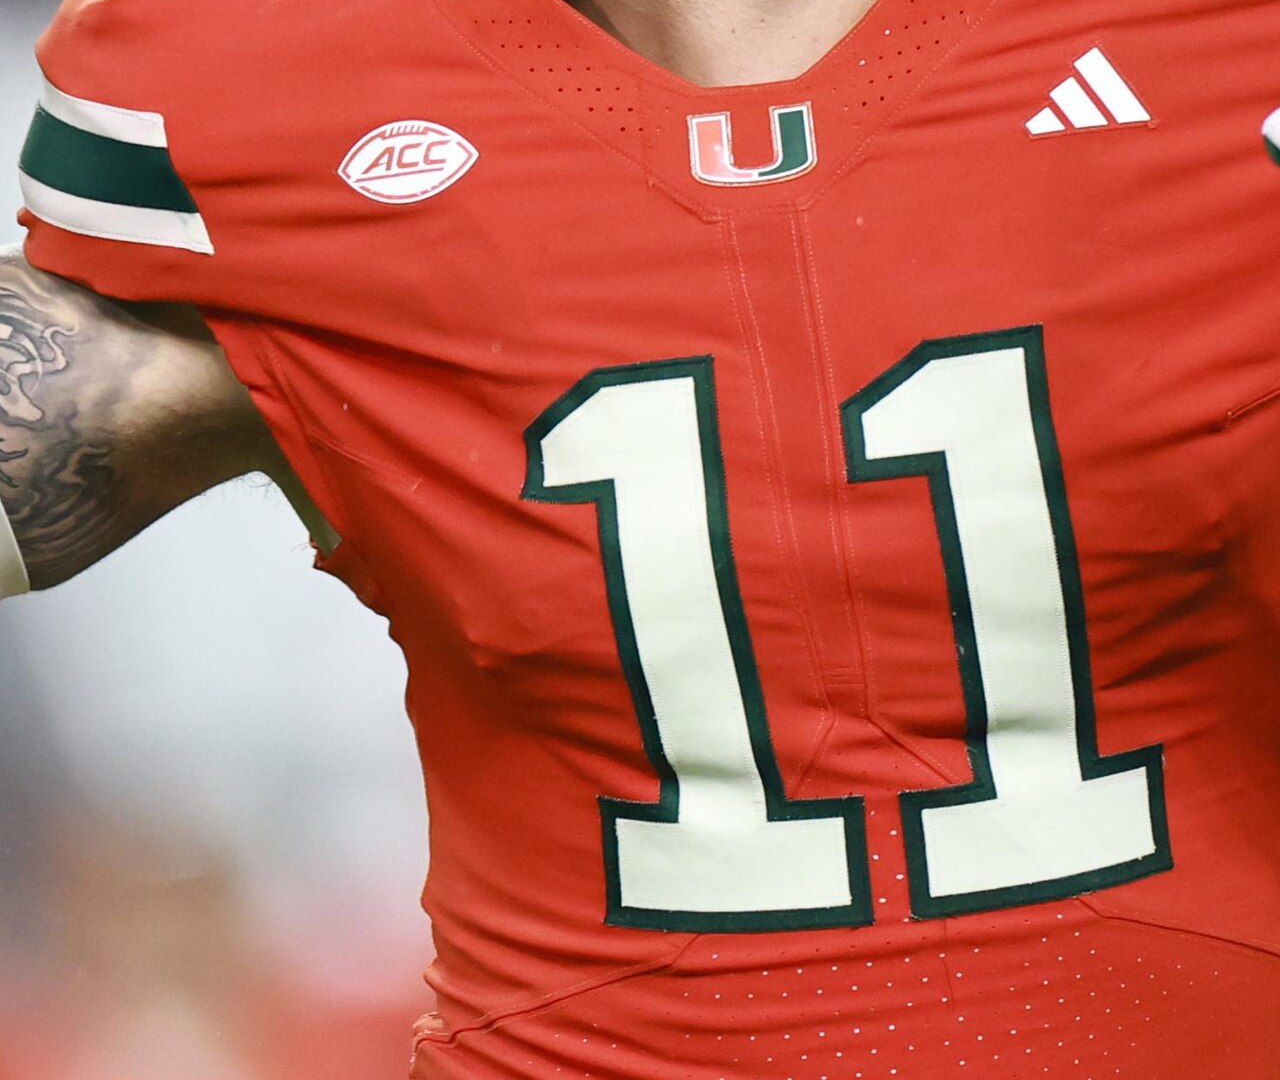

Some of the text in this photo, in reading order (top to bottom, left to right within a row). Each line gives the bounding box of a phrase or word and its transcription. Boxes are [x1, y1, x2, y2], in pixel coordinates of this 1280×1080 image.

[361, 140, 452, 175] ACC
[686, 101, 817, 187] U
[520, 323, 1174, 934] 11
